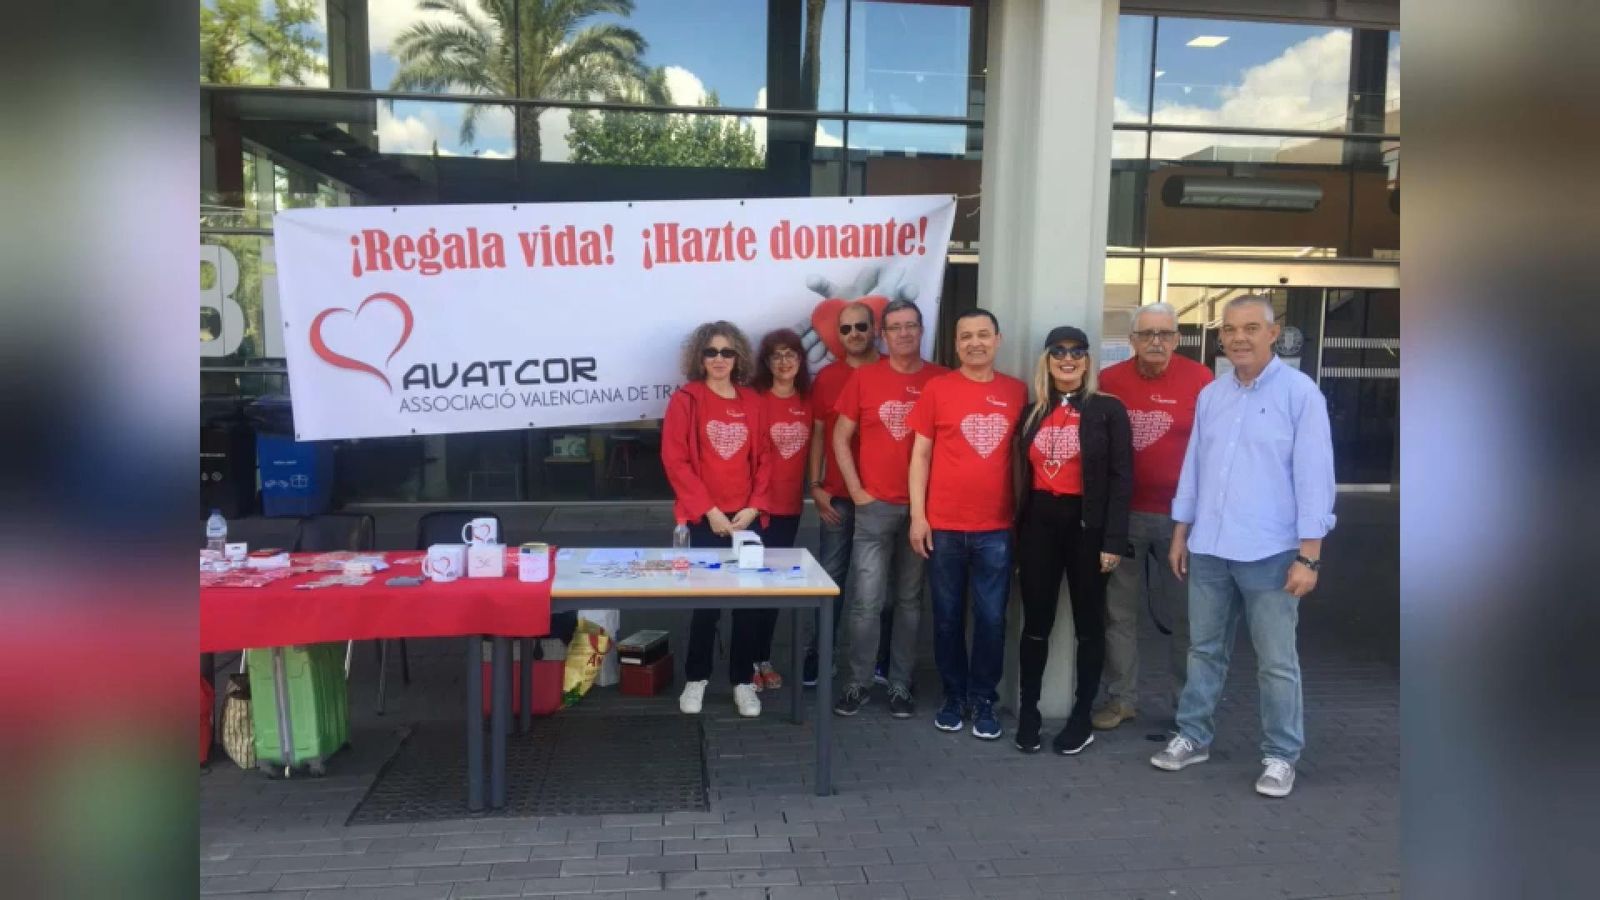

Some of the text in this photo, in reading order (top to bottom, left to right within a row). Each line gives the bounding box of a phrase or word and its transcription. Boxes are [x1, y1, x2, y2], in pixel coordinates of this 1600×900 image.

[351, 216, 928, 277] ¡Regala vida! ¡Hazte donante!
[403, 357, 597, 390] AVATCOR
[400, 388, 515, 413] ASSOCIACIÓ
[520, 387, 624, 407] VALENCIANA
[628, 386, 649, 402] DE
